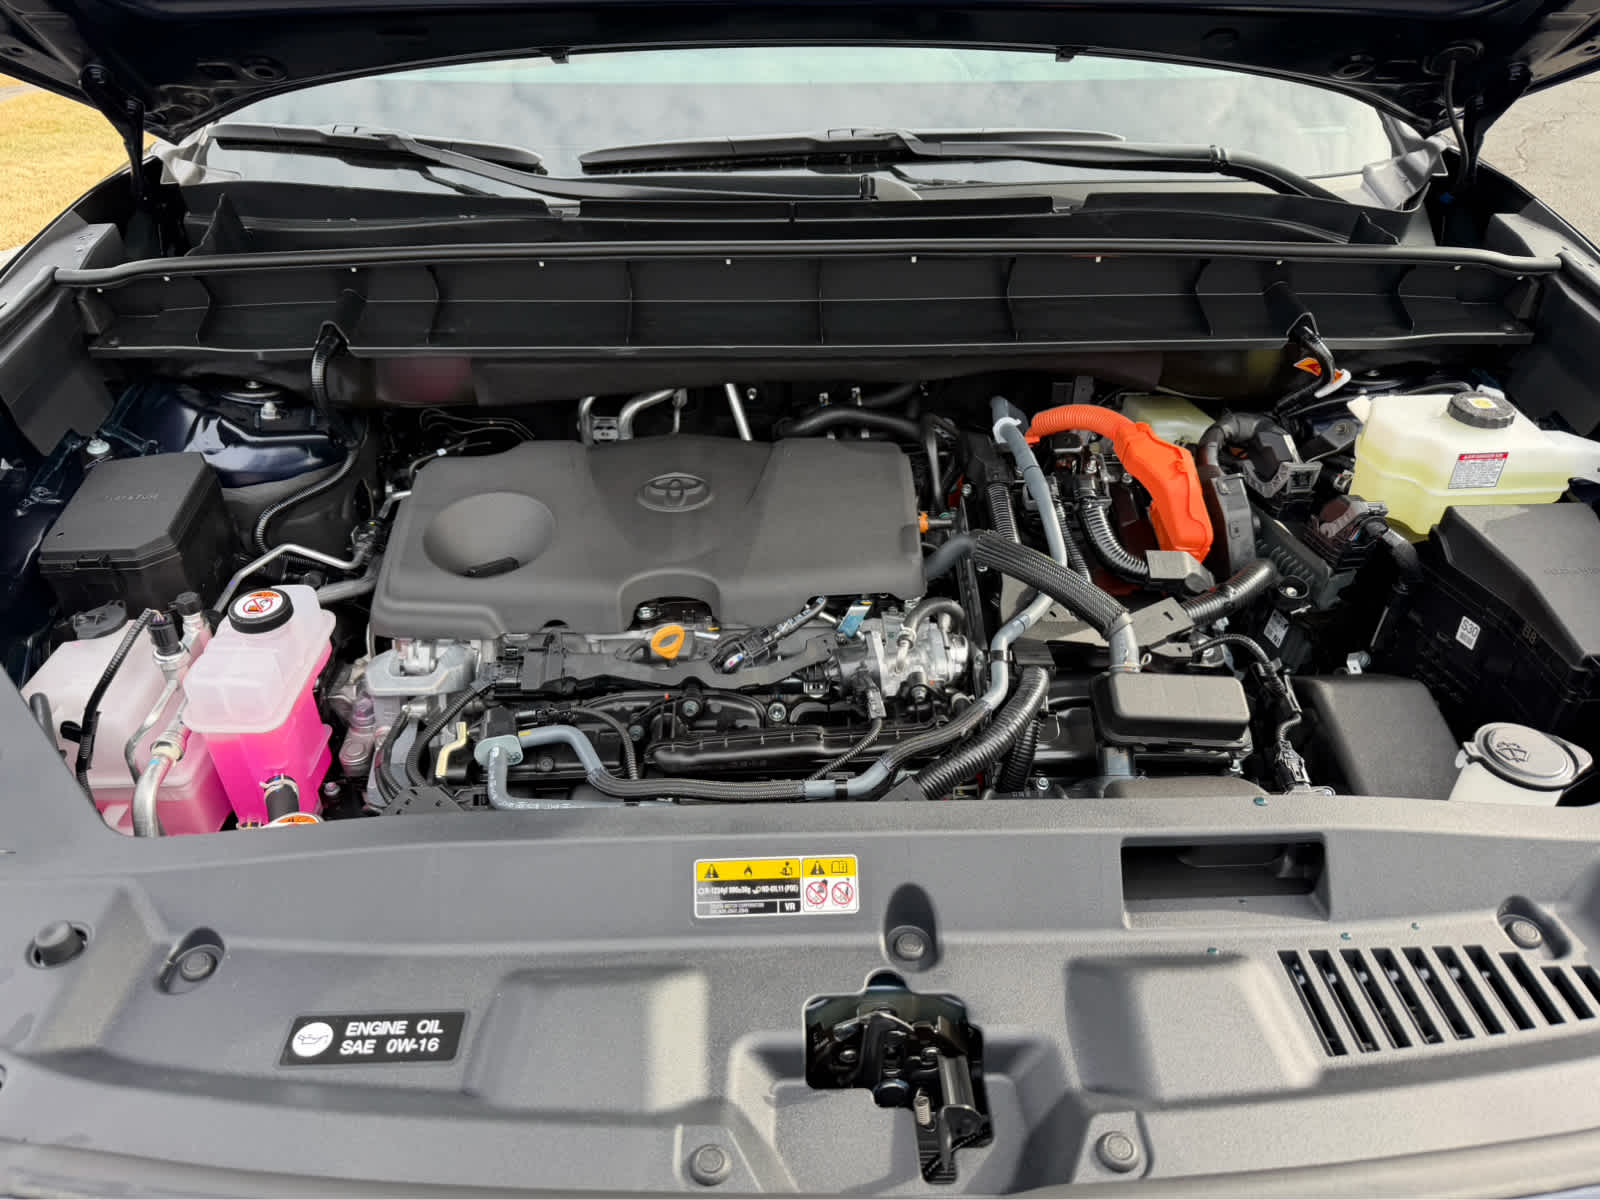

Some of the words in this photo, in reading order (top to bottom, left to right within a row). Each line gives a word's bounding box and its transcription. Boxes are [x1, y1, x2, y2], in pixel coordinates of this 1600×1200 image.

[1461, 619, 1479, 638] S30
[784, 902, 796, 911] VR
[345, 1020, 408, 1036] ENGINE
[416, 1019, 444, 1035] OIL
[339, 1039, 376, 1055] SAE
[385, 1037, 440, 1054] 0W-16
